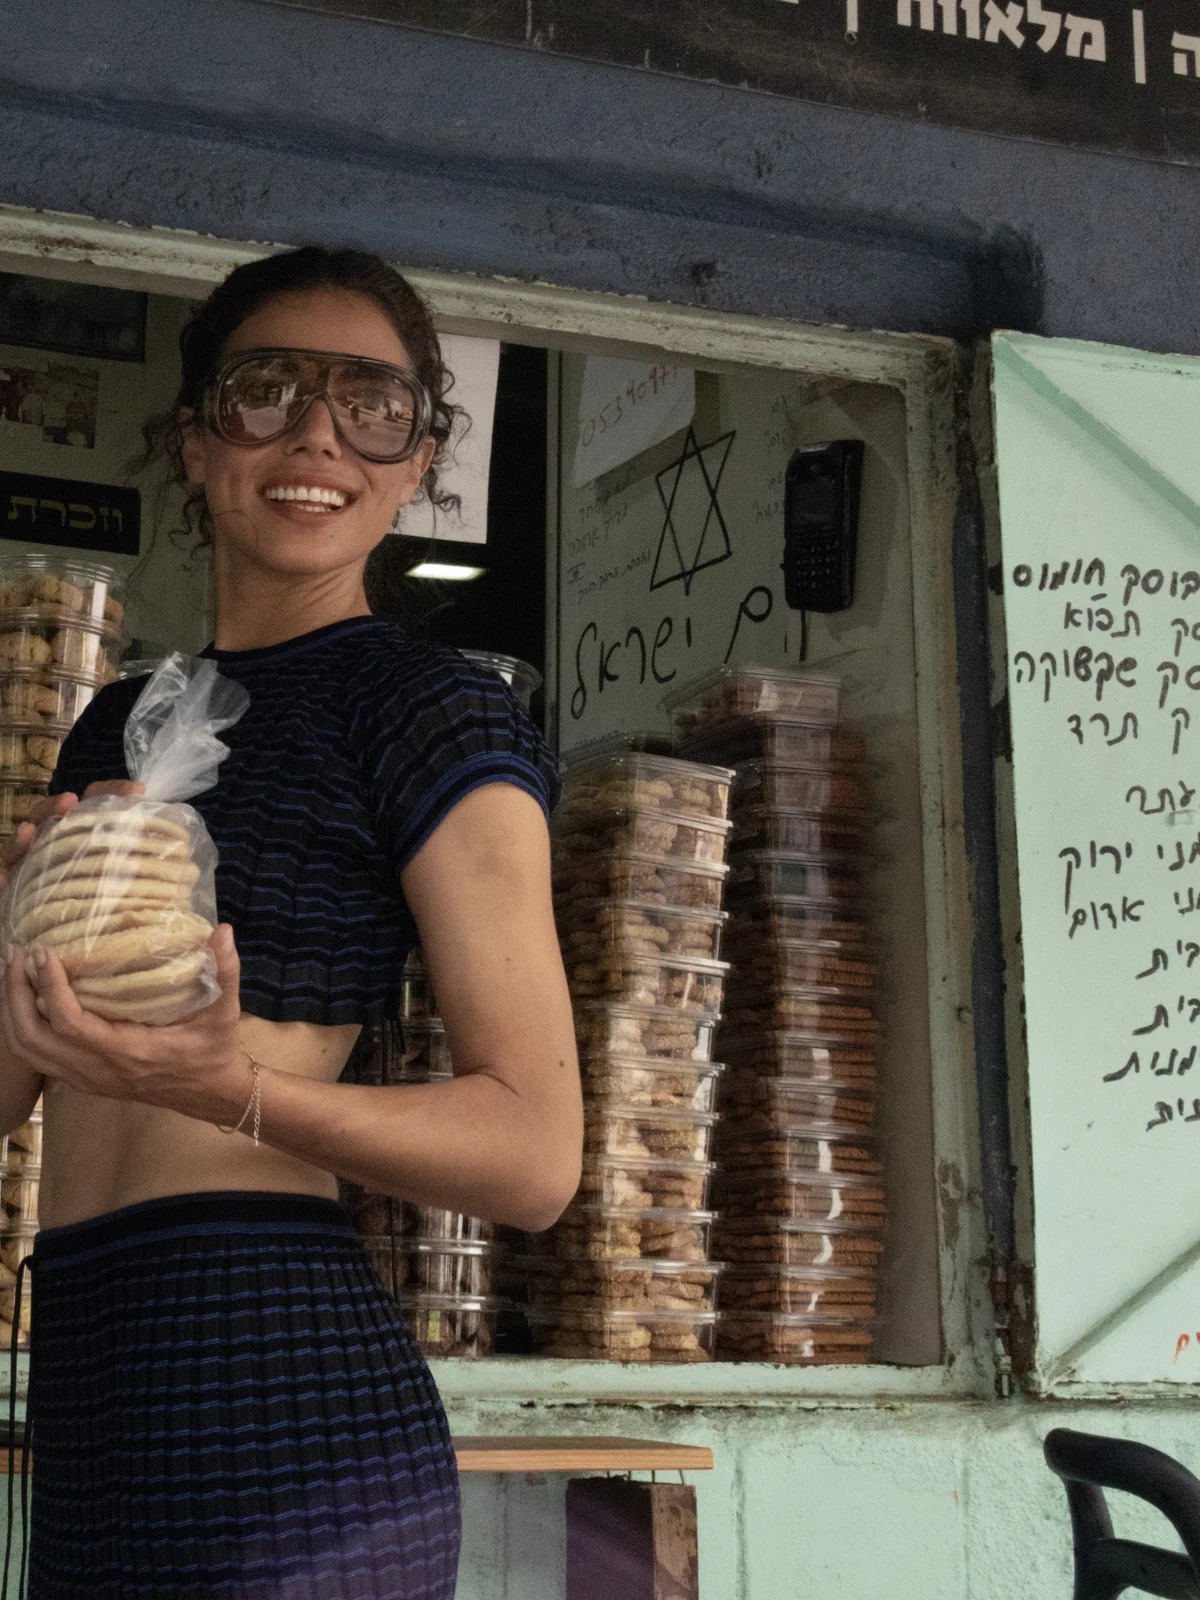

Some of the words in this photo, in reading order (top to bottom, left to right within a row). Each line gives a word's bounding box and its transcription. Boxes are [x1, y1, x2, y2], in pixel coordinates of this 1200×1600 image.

[8, 494, 123, 534] וזכרת
[1012, 557, 1106, 592] חומוס
[570, 615, 693, 721] ישראל
[1013, 645, 1138, 703] שקשוקה
[1058, 840, 1132, 915] ירוק
[1065, 896, 1145, 939] אדום
